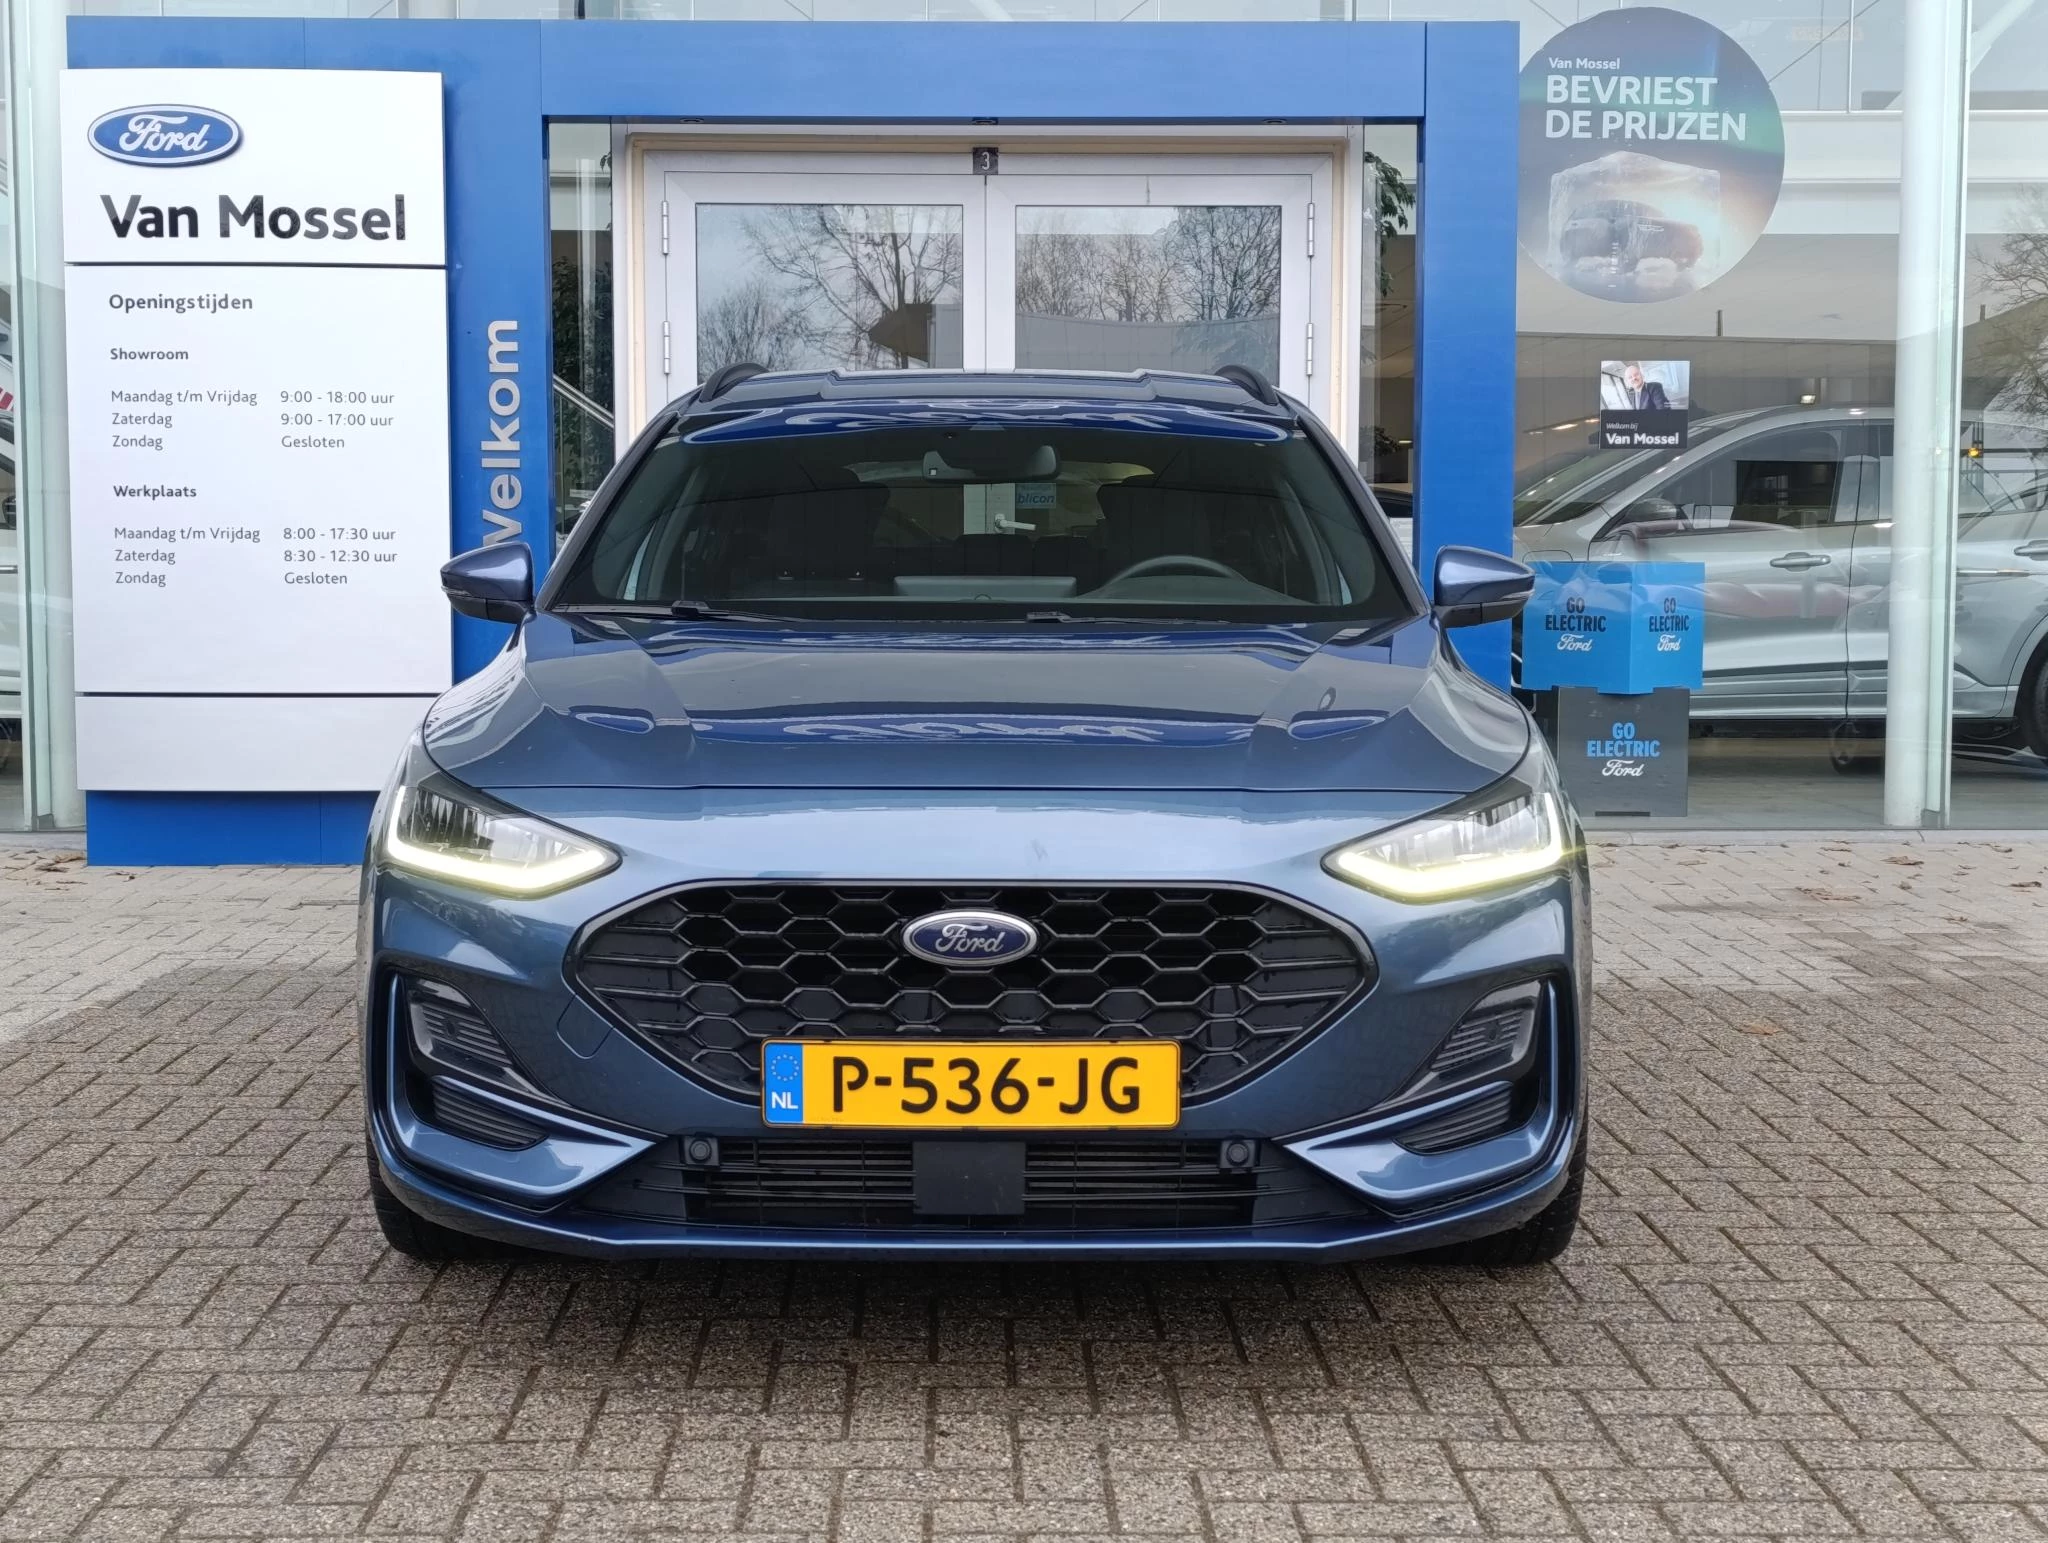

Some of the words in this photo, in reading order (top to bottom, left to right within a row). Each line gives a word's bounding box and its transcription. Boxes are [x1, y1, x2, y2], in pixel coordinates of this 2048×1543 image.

[1548, 57, 1572, 69] Van
[1575, 57, 1621, 70] Mossel
[1546, 74, 1718, 106] BEVRIEST
[119, 114, 210, 151] Ford
[1545, 109, 1592, 139] DE
[1602, 110, 1746, 141] PRIJZEN
[982, 151, 990, 170] 3
[101, 195, 198, 239] Van
[219, 194, 406, 241] Mossel
[109, 294, 253, 314] Openingstijden
[110, 347, 189, 361] Showroom
[111, 390, 174, 406] Maandag
[176, 391, 203, 403] t/m
[207, 390, 258, 406] Vrijdag
[280, 390, 313, 403] 9:00
[327, 391, 367, 404] 18:00
[371, 394, 394, 404] uur
[111, 412, 173, 428] Zaterdag
[280, 413, 313, 426] 9:00
[327, 413, 366, 426] 17:00
[370, 417, 393, 426] uur
[112, 435, 163, 451] Zondag
[281, 436, 345, 448] Gesloten
[1606, 433, 1630, 445] Van
[1634, 432, 1679, 445] Mossel
[113, 484, 197, 501] Werkplaats
[114, 527, 176, 543] Maandag
[180, 527, 206, 540] t/m
[210, 527, 261, 543] Vrijdag
[283, 527, 316, 540] 8:00
[330, 527, 368, 540] 17:30
[372, 531, 396, 540] uur
[115, 549, 176, 565] Zaterdag
[284, 550, 316, 562] 8:30
[330, 550, 370, 562] 12:30
[374, 553, 398, 562] uur
[115, 571, 167, 587] Zondag
[284, 572, 348, 585] Gesloten
[1566, 597, 1585, 613] GO
[1664, 597, 1676, 614] GO
[1545, 615, 1606, 632] ELECTRIC
[1649, 615, 1689, 632] ELECTRIC
[1557, 633, 1592, 651] Ford
[1657, 634, 1681, 651] Ford
[1612, 722, 1635, 739] GO
[1587, 740, 1661, 757] ELECTRIC
[1602, 759, 1645, 777] Ford
[935, 923, 1006, 952] Ford
[832, 1055, 1140, 1115] P-536-JG
[771, 1091, 799, 1110] NL
